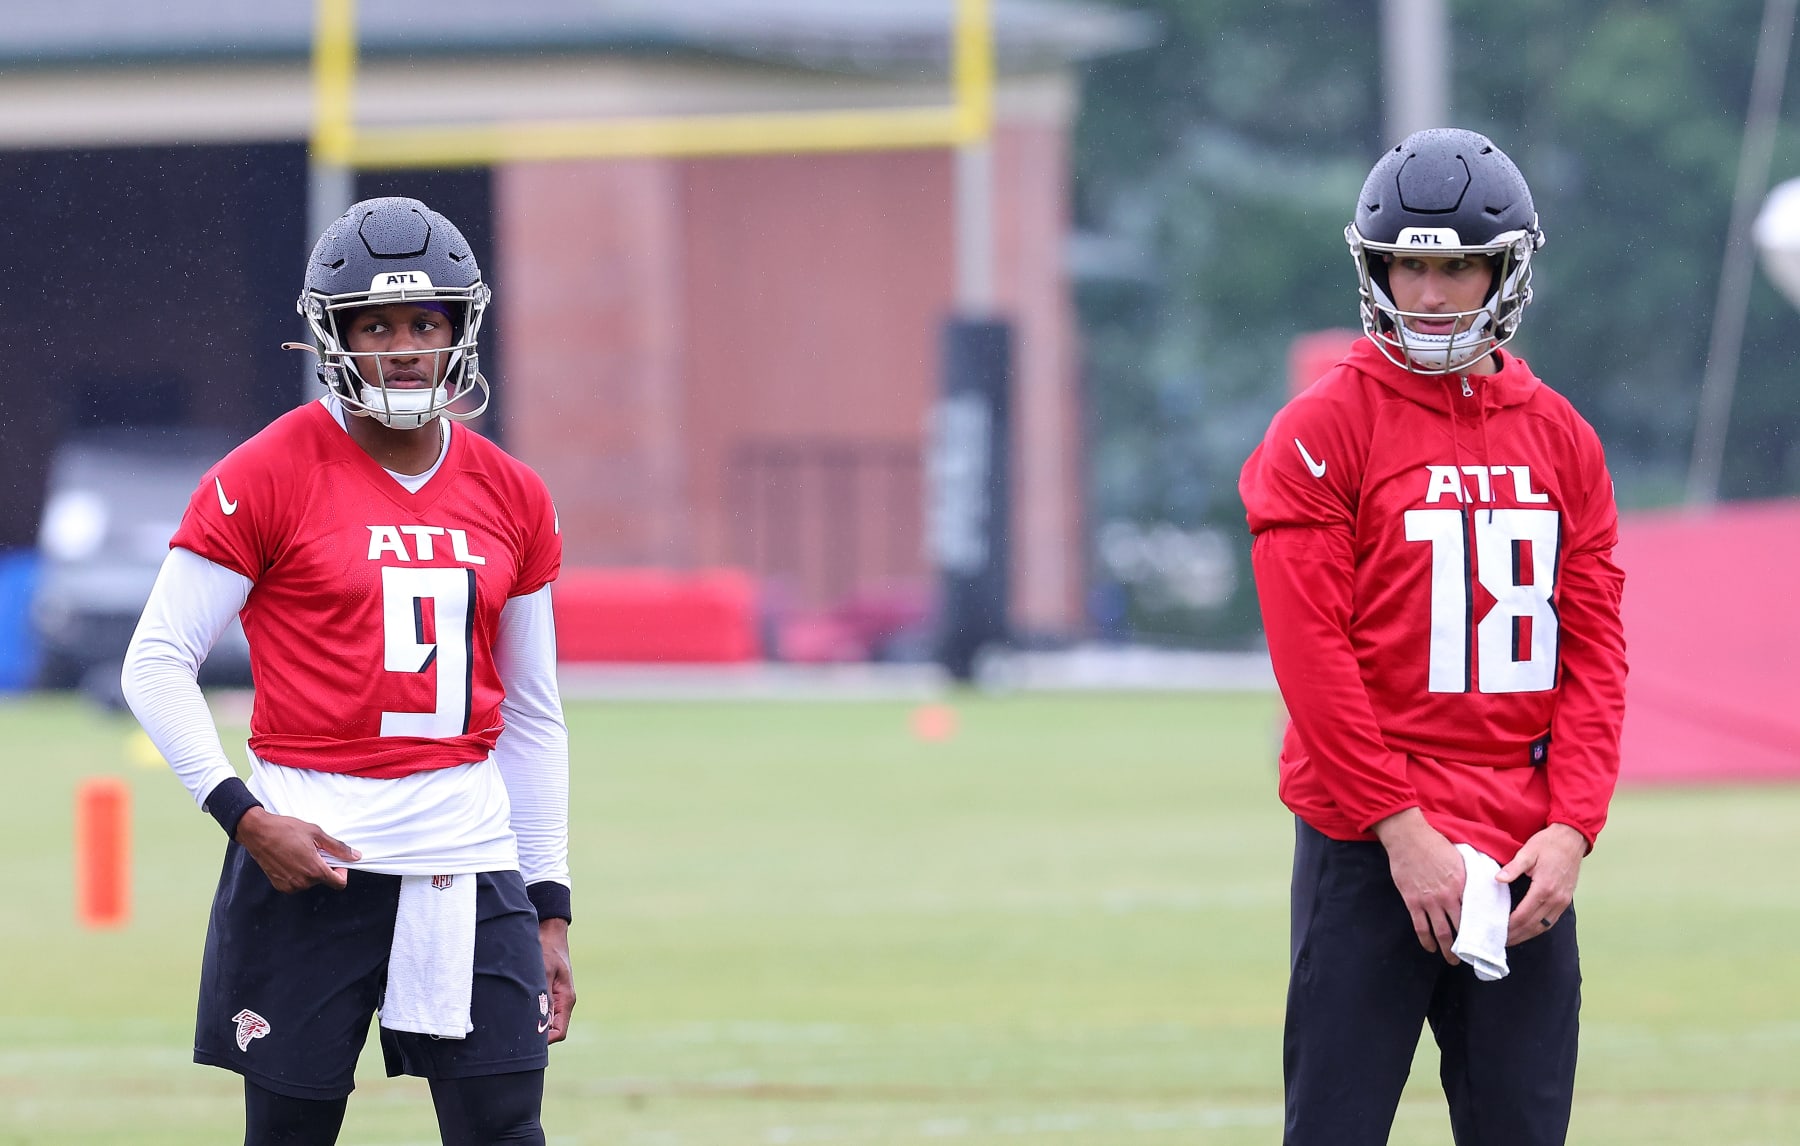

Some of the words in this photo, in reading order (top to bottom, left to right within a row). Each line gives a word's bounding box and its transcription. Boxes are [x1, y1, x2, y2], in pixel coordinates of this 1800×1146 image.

[1410, 234, 1442, 245] ATL
[386, 274, 418, 285] ATL
[1425, 465, 1549, 503] ATL
[366, 525, 486, 565] ATL
[1404, 509, 1561, 693] 18
[380, 566, 477, 738] 9
[431, 874, 452, 888] NFL
